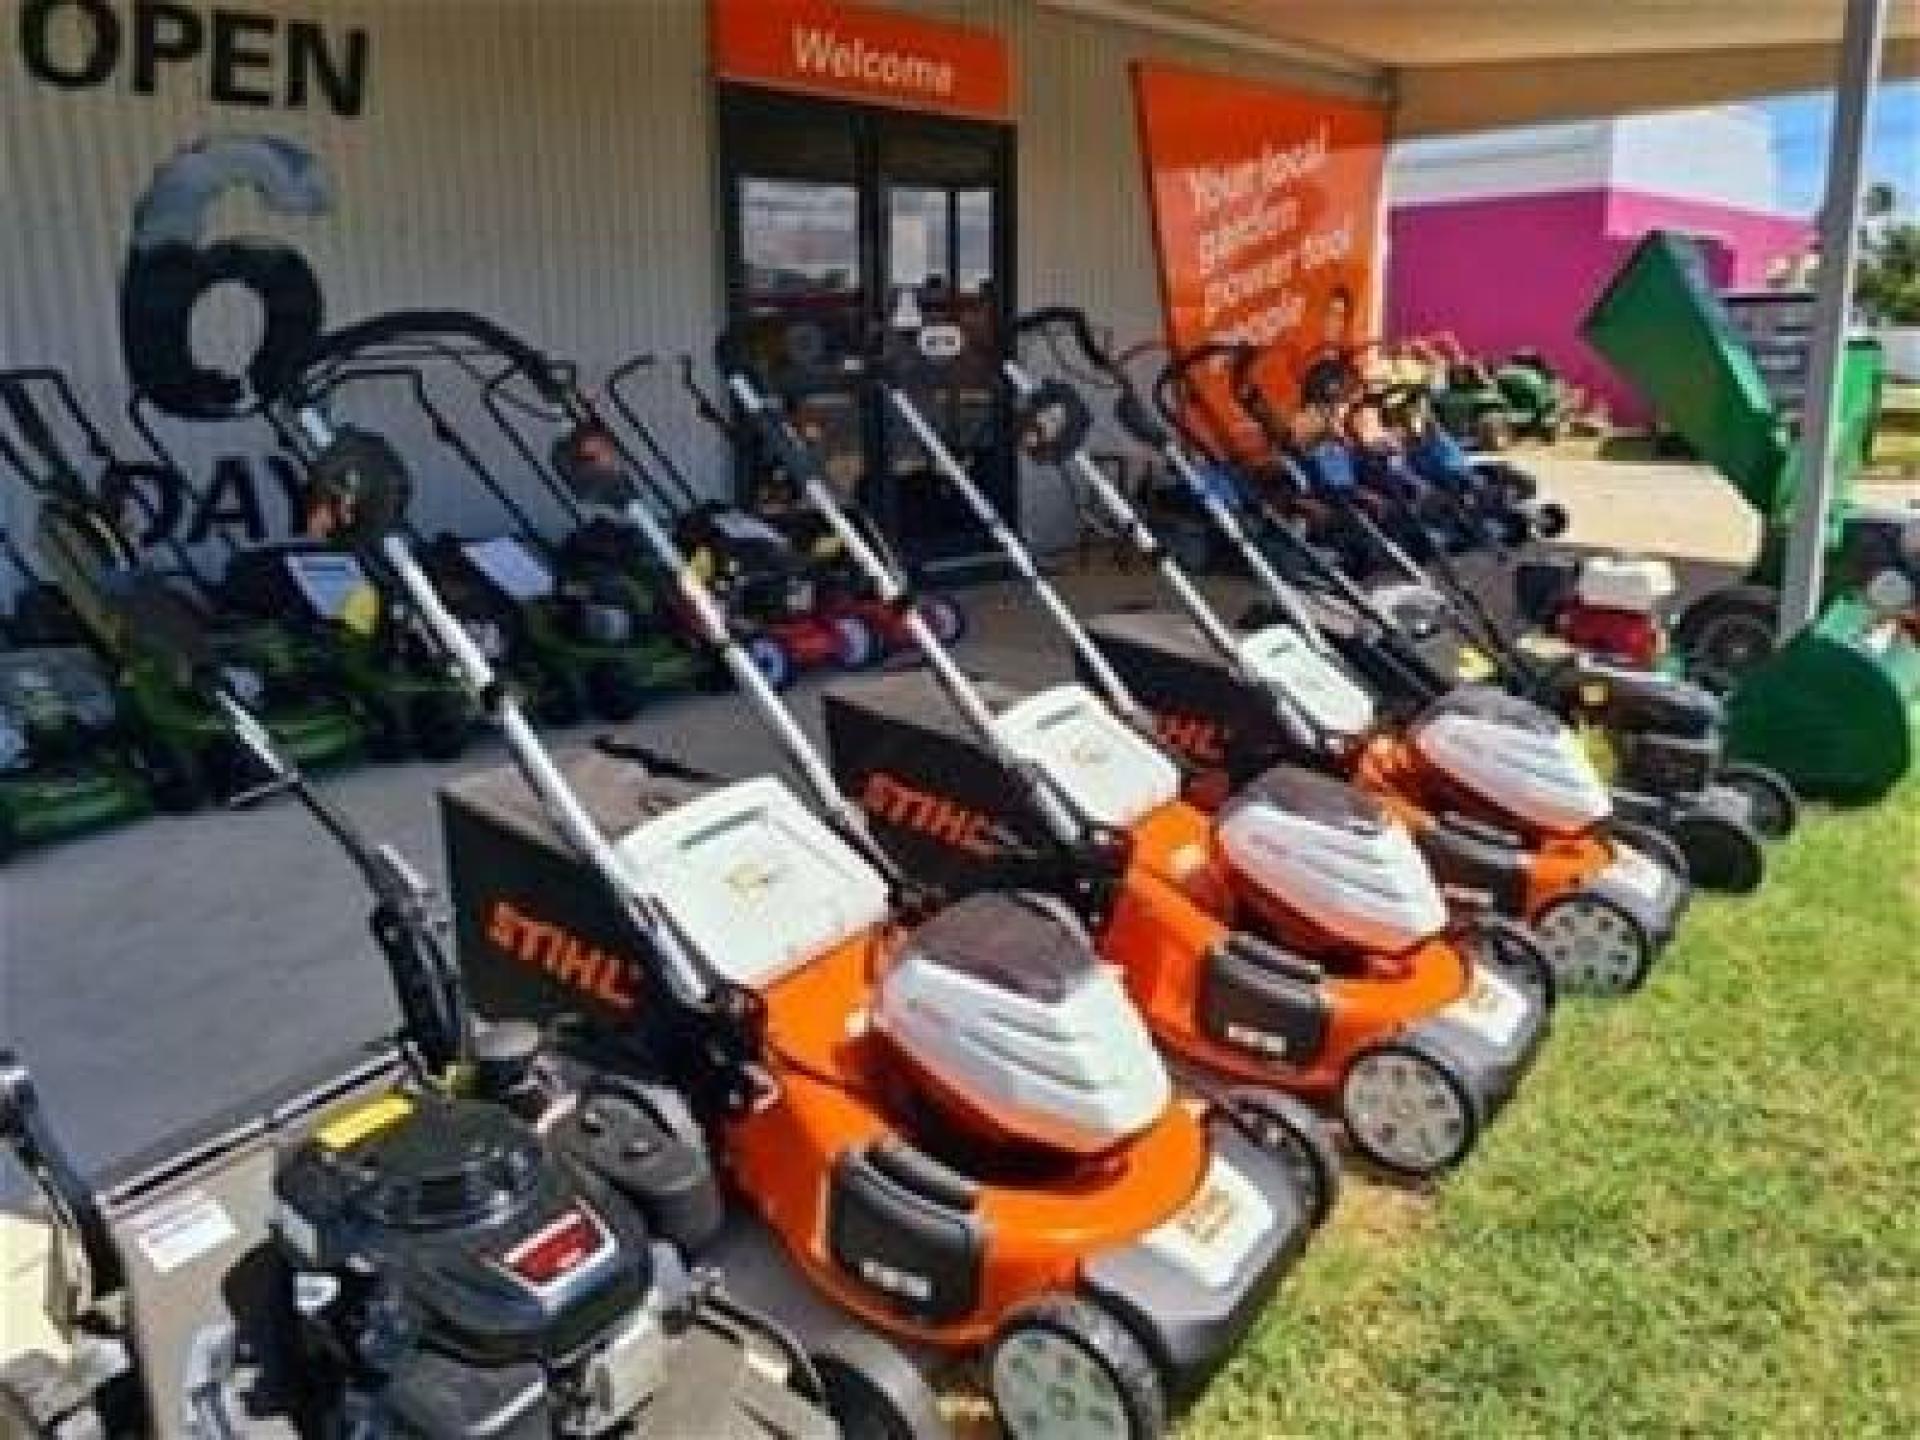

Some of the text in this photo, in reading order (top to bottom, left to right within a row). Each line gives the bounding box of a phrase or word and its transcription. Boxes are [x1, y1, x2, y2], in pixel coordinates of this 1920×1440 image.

[20, 0, 369, 118] OPEN
[791, 25, 952, 95] Welcome
[121, 134, 328, 419] 6
[862, 771, 1000, 857] STIHL
[487, 900, 637, 1009] STIHL
